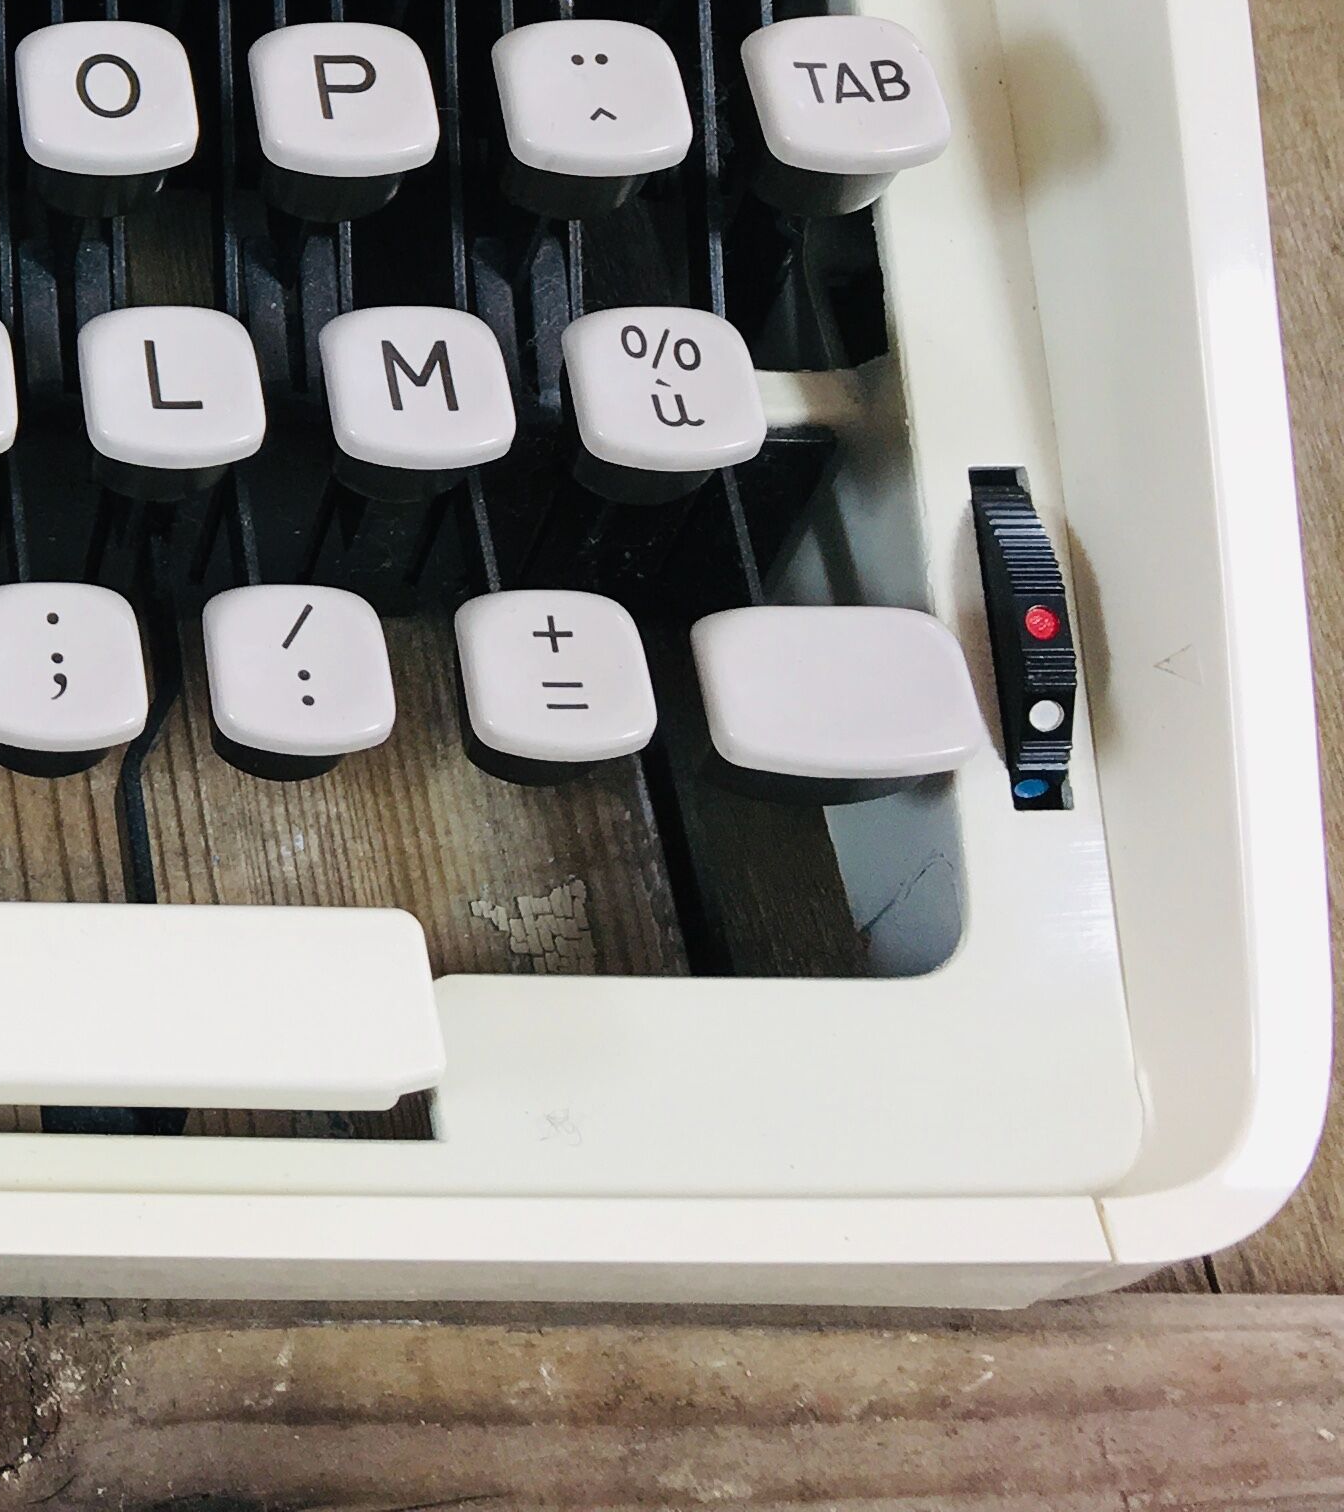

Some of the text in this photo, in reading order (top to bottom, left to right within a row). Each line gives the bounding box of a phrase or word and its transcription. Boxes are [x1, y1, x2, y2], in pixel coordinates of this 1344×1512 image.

[74, 52, 142, 120] O
[312, 53, 378, 121] P
[792, 58, 912, 105] TAB
[142, 338, 205, 411] L
[380, 338, 461, 413] M
